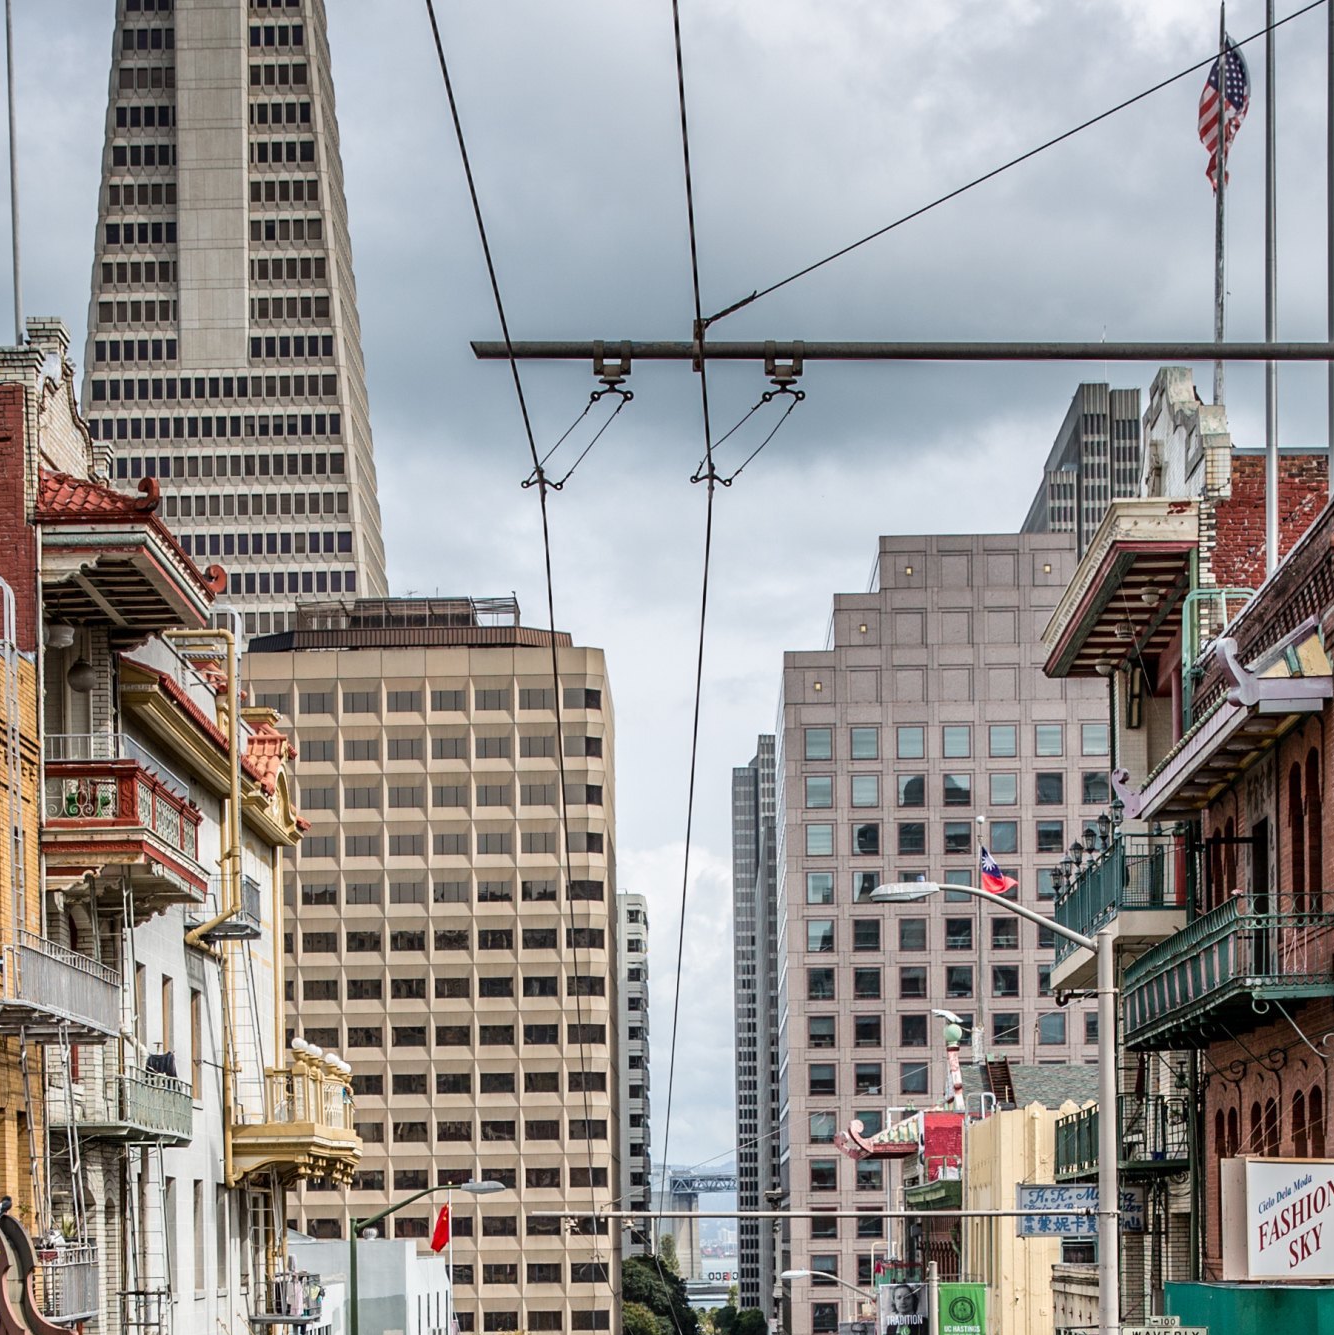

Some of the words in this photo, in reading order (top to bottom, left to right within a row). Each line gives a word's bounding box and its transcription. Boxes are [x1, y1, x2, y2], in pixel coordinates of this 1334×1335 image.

[1293, 1174, 1312, 1193] Moda
[1289, 1222, 1323, 1269] SKY
[886, 1315, 922, 1325] TRADITION
